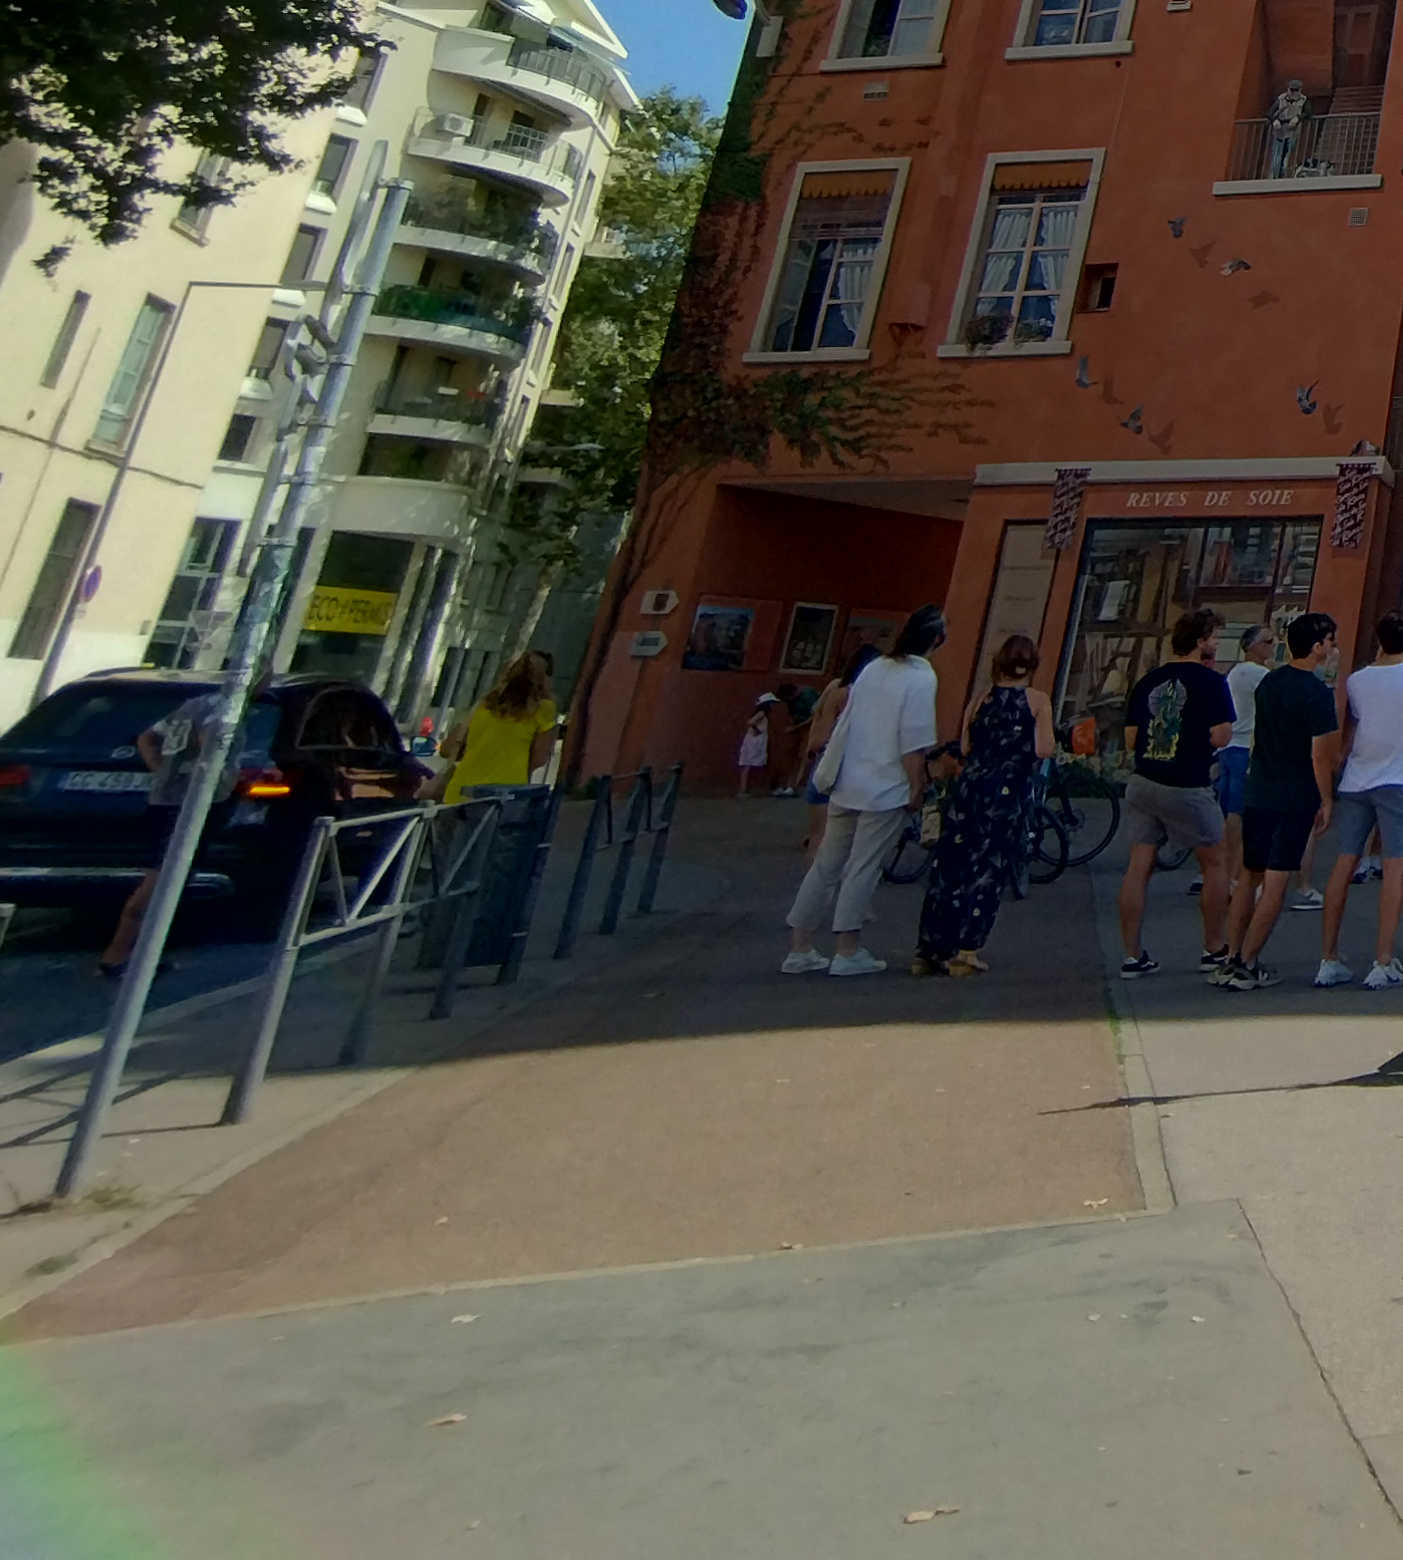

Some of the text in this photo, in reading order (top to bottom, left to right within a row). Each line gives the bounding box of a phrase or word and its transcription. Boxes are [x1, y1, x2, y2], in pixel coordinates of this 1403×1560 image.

[1125, 489, 1296, 508] REVES DE SOIE
